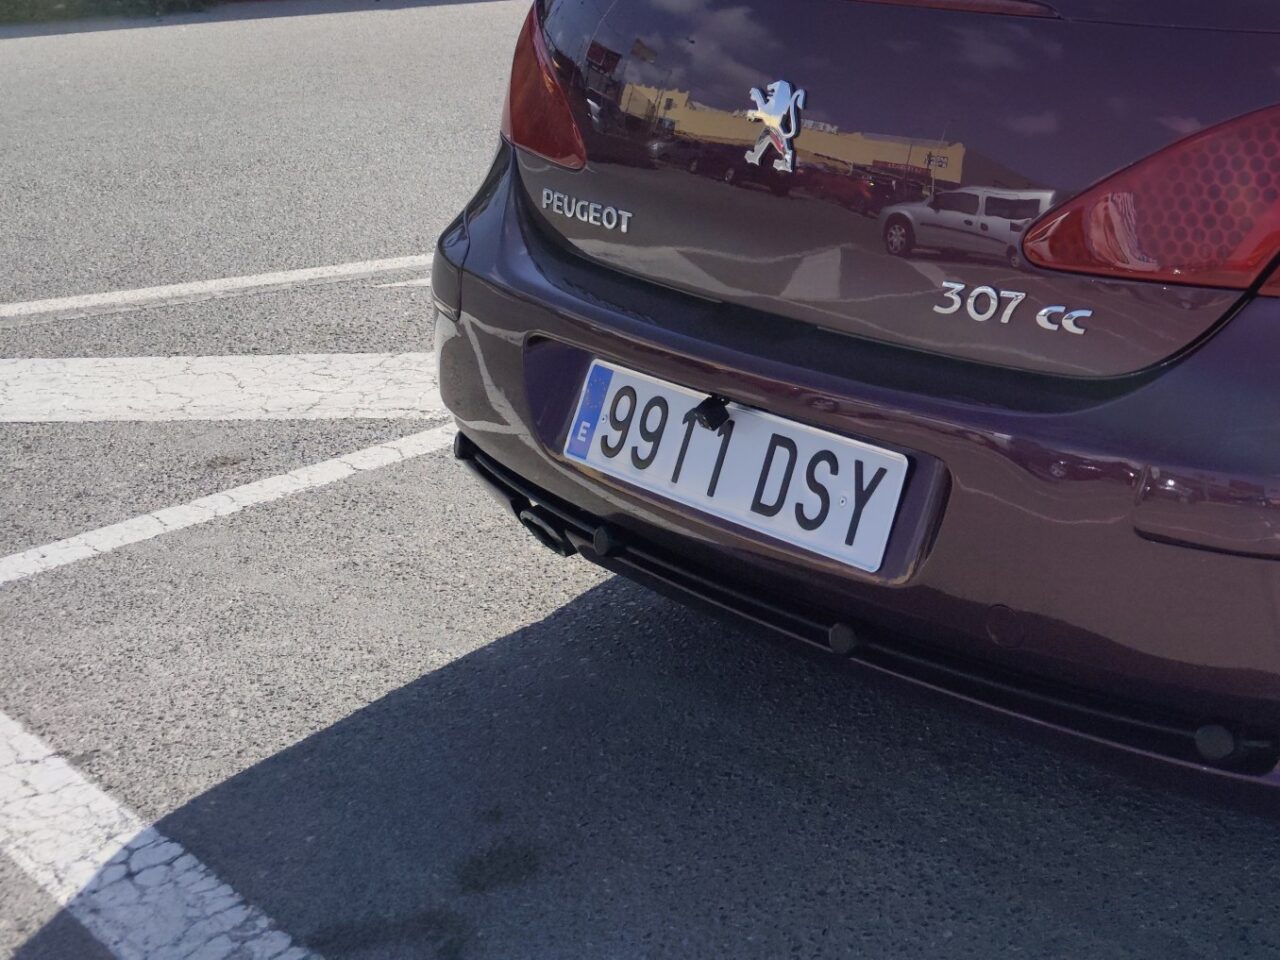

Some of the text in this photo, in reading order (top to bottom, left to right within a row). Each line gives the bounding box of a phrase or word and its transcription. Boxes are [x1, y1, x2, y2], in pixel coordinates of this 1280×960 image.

[541, 187, 633, 234] PEUGEOT
[932, 280, 1027, 325] 307
[577, 421, 591, 443] E
[600, 385, 888, 547] 9911 DSY
